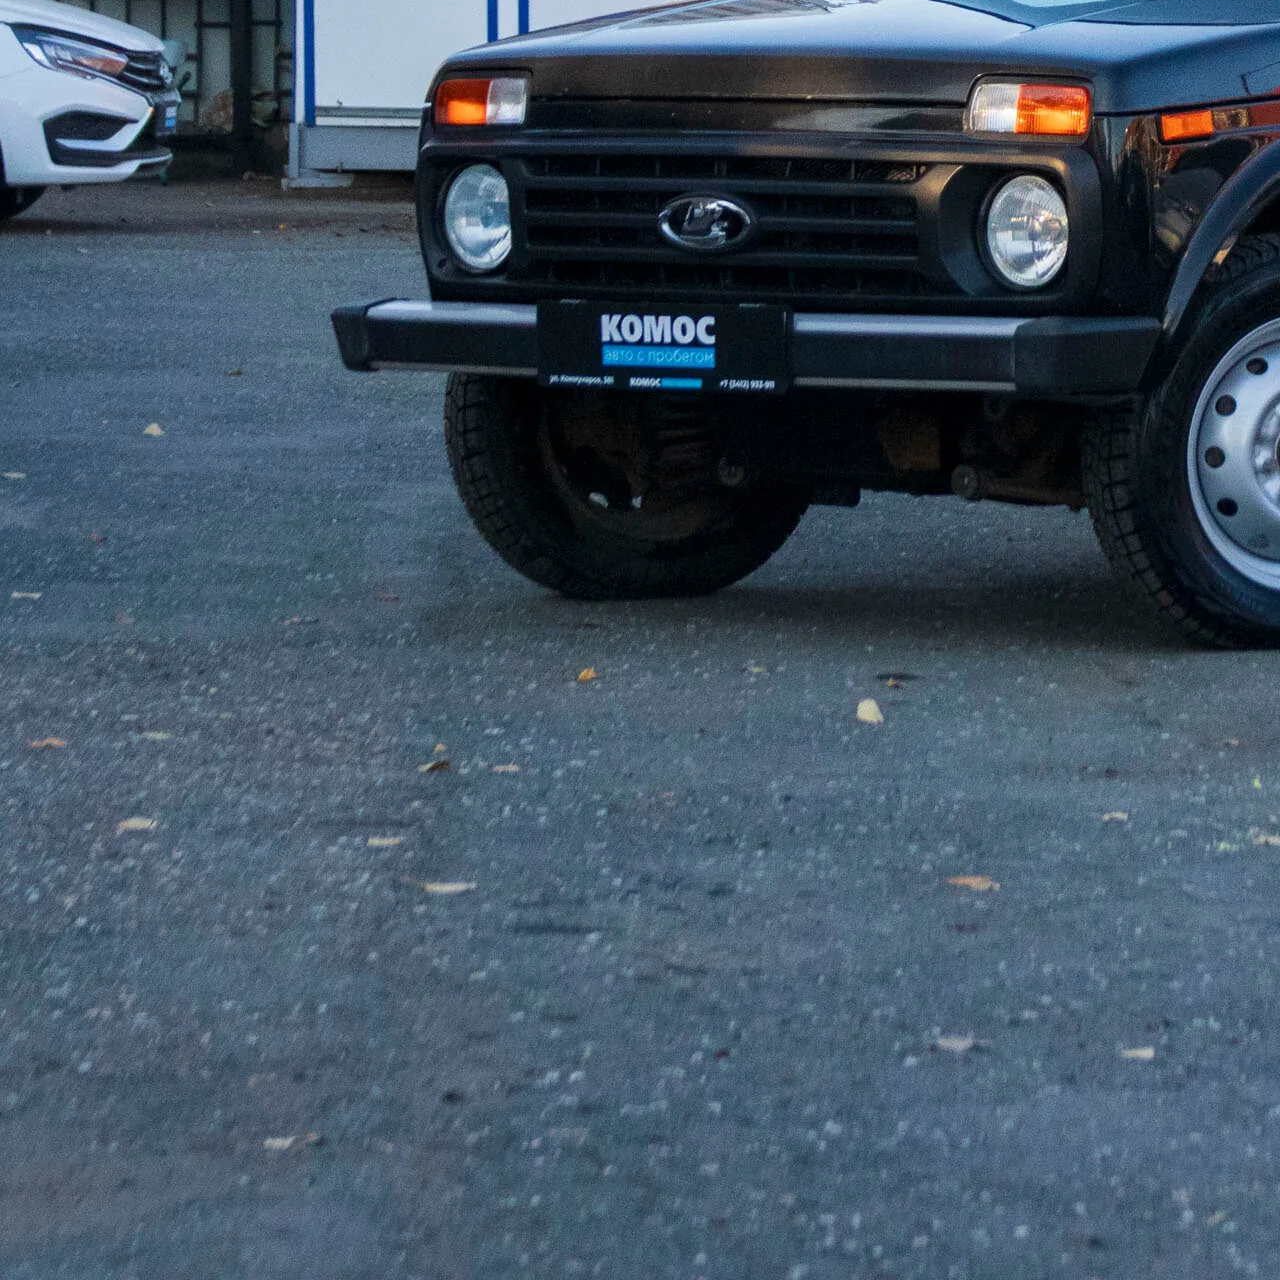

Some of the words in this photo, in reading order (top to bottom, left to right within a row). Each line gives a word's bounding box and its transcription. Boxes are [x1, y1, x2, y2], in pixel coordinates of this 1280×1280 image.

[601, 314, 716, 345] КОМОС
[605, 350, 634, 362] авто
[636, 352, 645, 362] с
[648, 349, 714, 365] пробегом
[629, 376, 661, 387] КОМОС
[719, 379, 728, 388] +7
